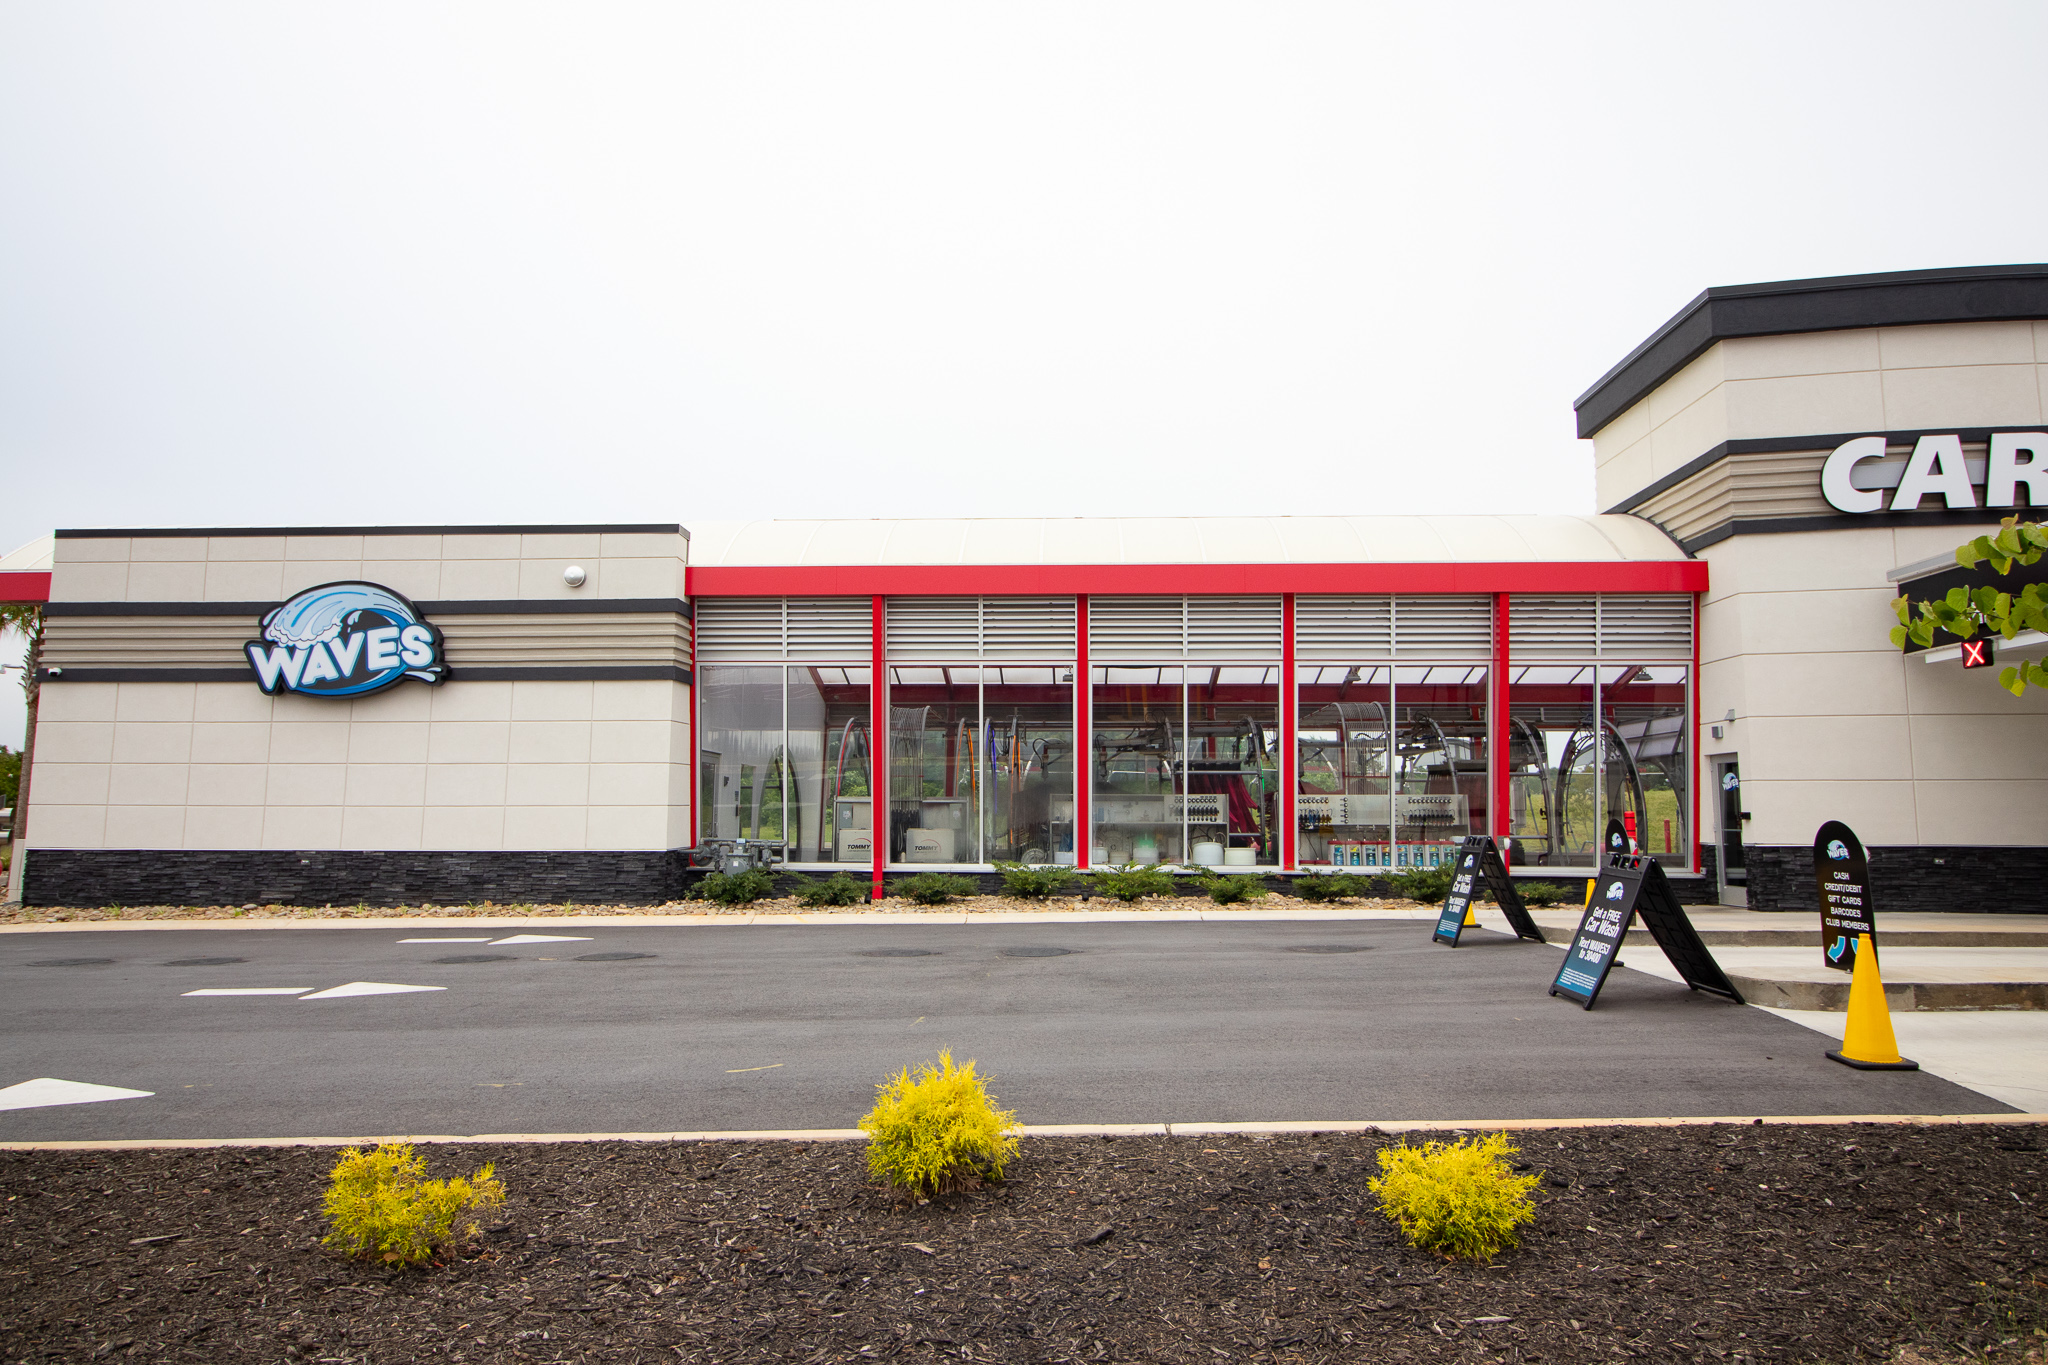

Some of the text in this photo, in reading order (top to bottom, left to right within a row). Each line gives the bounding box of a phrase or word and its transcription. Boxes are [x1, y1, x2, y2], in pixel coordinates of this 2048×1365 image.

[1821, 432, 2048, 514] CAR
[248, 622, 435, 691] WAVES
[1722, 777, 1739, 791] WAVES
[1827, 847, 1850, 860] WAVES
[1833, 871, 1850, 881] CASH
[1824, 882, 1862, 894] CREDIT/DEBIT
[1828, 894, 1862, 906] GIFT CARDS
[1593, 906, 1604, 919] Get
[1606, 909, 1622, 923] FREE
[1830, 906, 1861, 918] BARCODES
[1585, 917, 1620, 938] Car Wash
[1825, 917, 1870, 931] CLUB MEMBERS
[1578, 936, 1591, 949] Text
[1579, 948, 1586, 959] to
